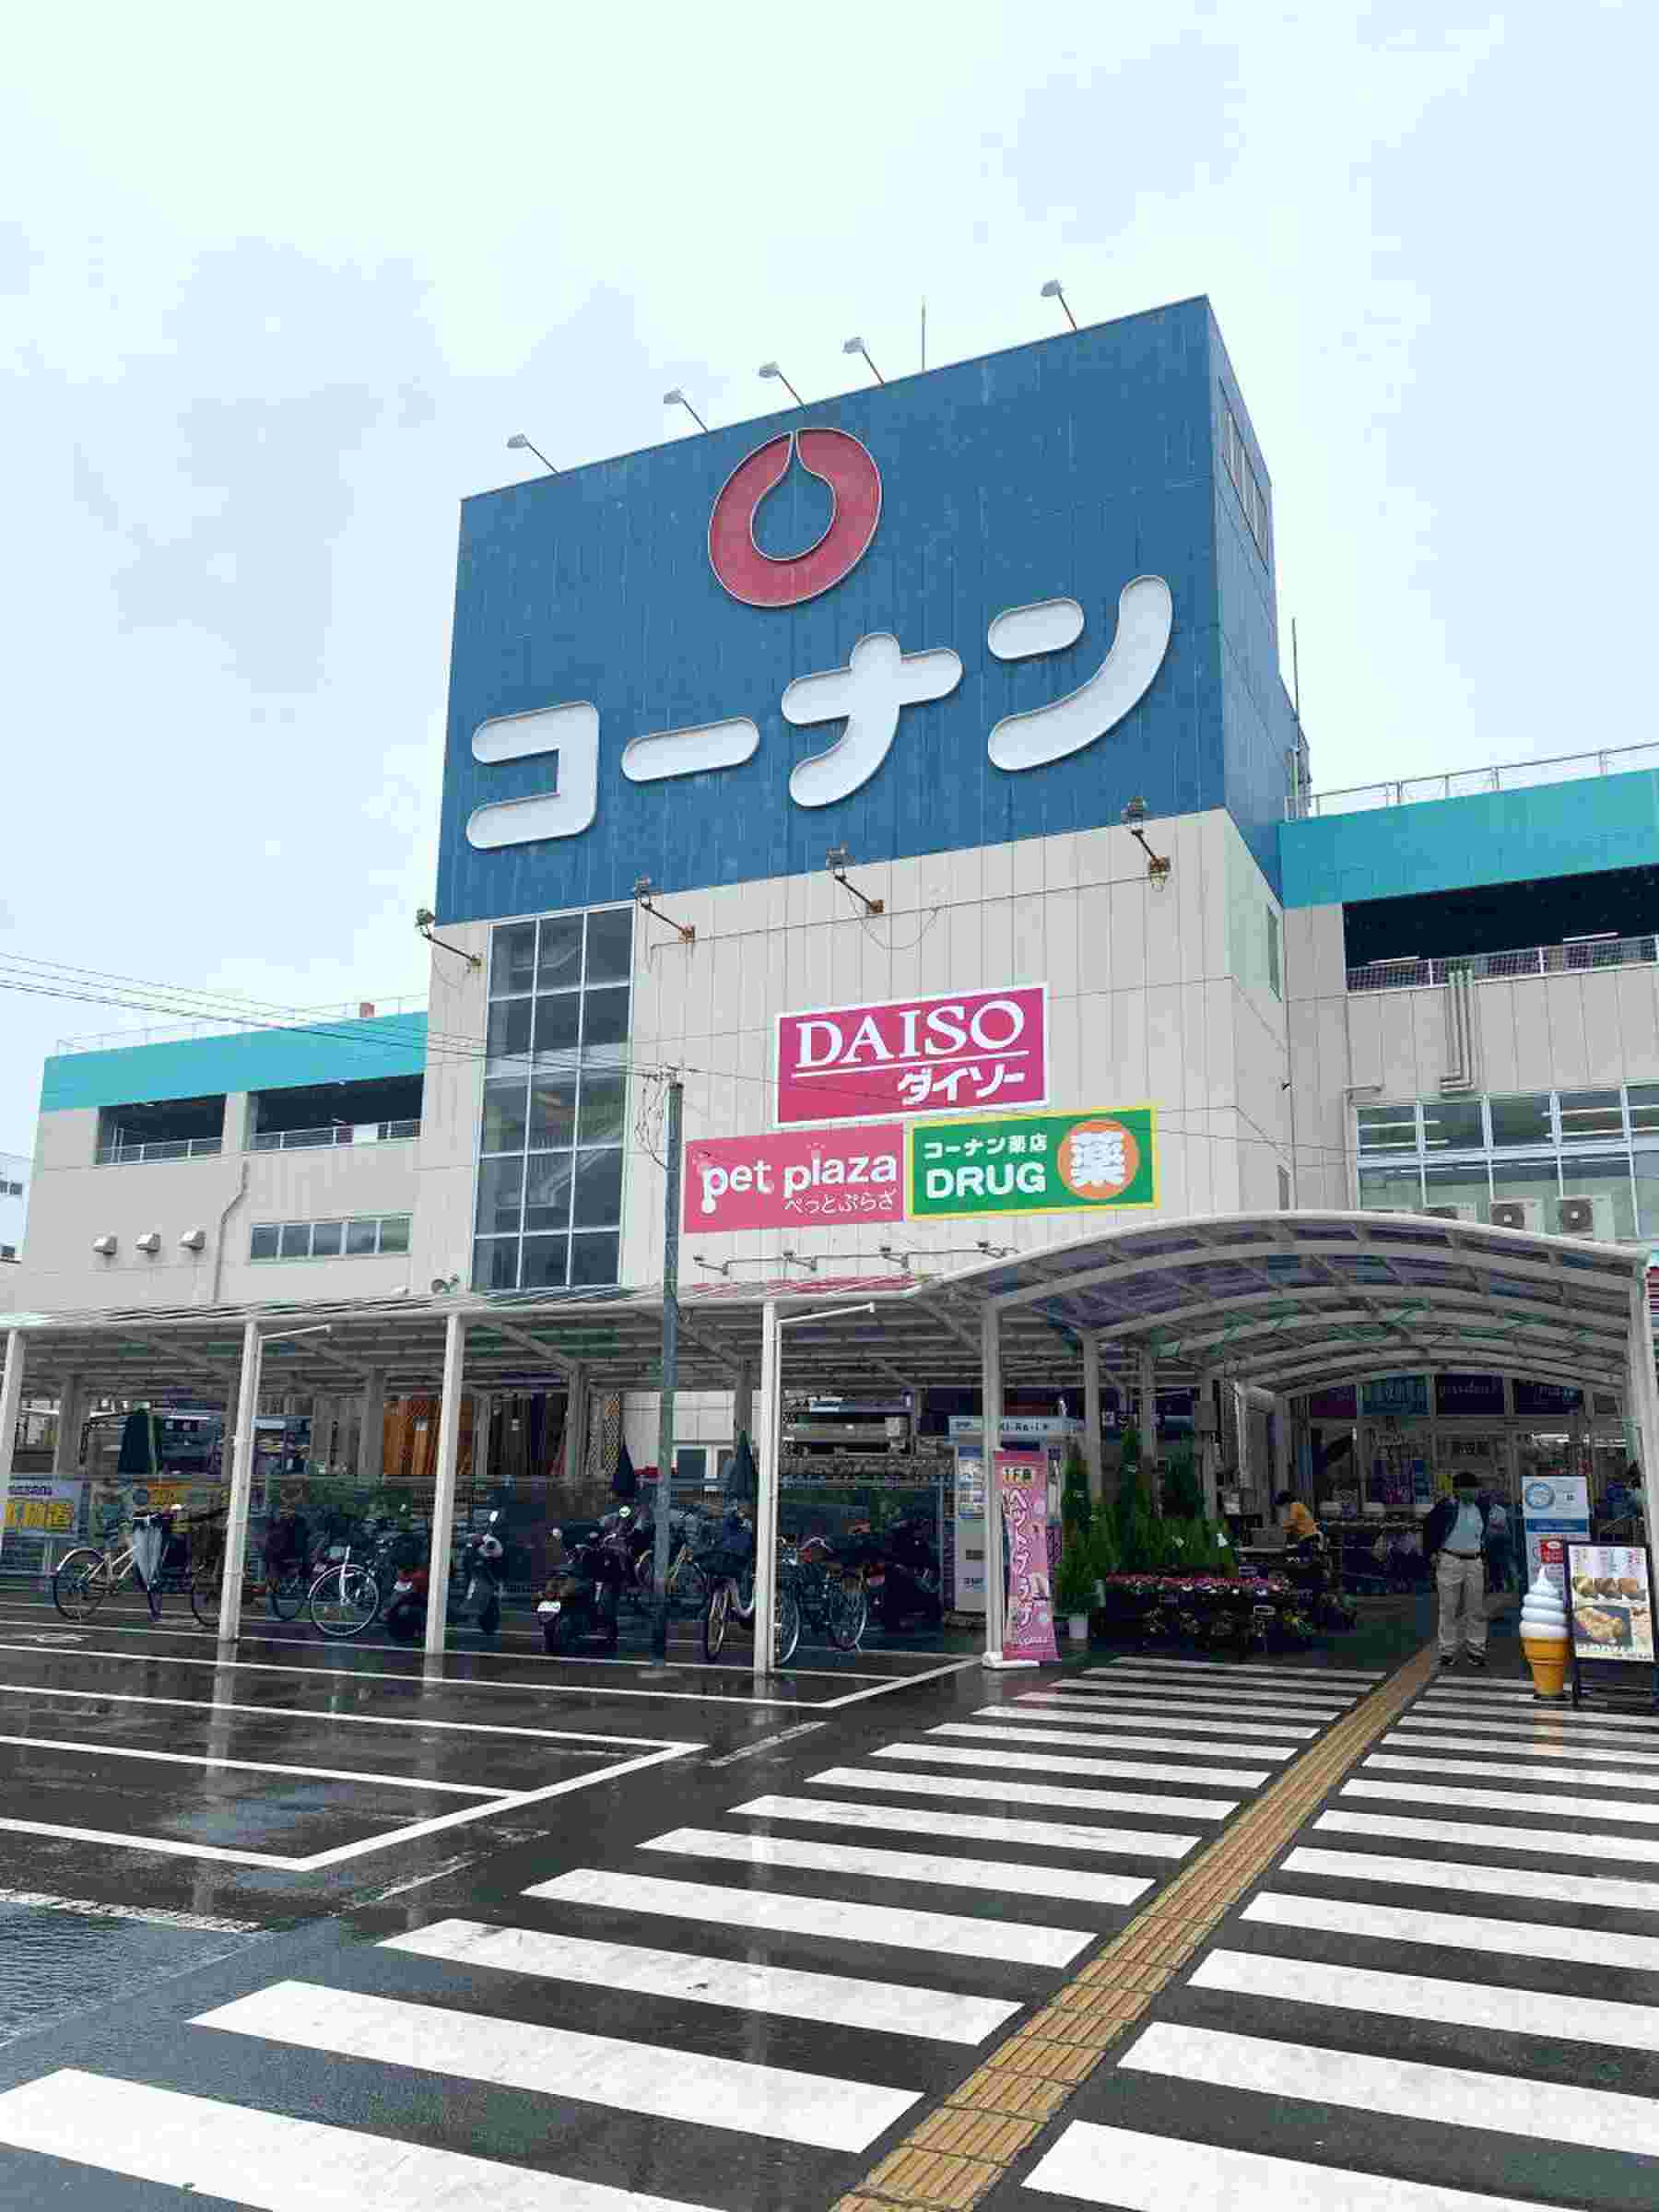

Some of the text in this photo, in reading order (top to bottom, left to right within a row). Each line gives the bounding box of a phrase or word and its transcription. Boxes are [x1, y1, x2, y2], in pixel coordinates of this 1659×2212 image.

[465, 575, 1173, 850] コーナン
[795, 1000, 1026, 1068] DAISO
[898, 1062, 1025, 1106] ダイソー
[700, 1149, 897, 1214] pet plaza
[926, 1161, 1047, 1199] DRUG
